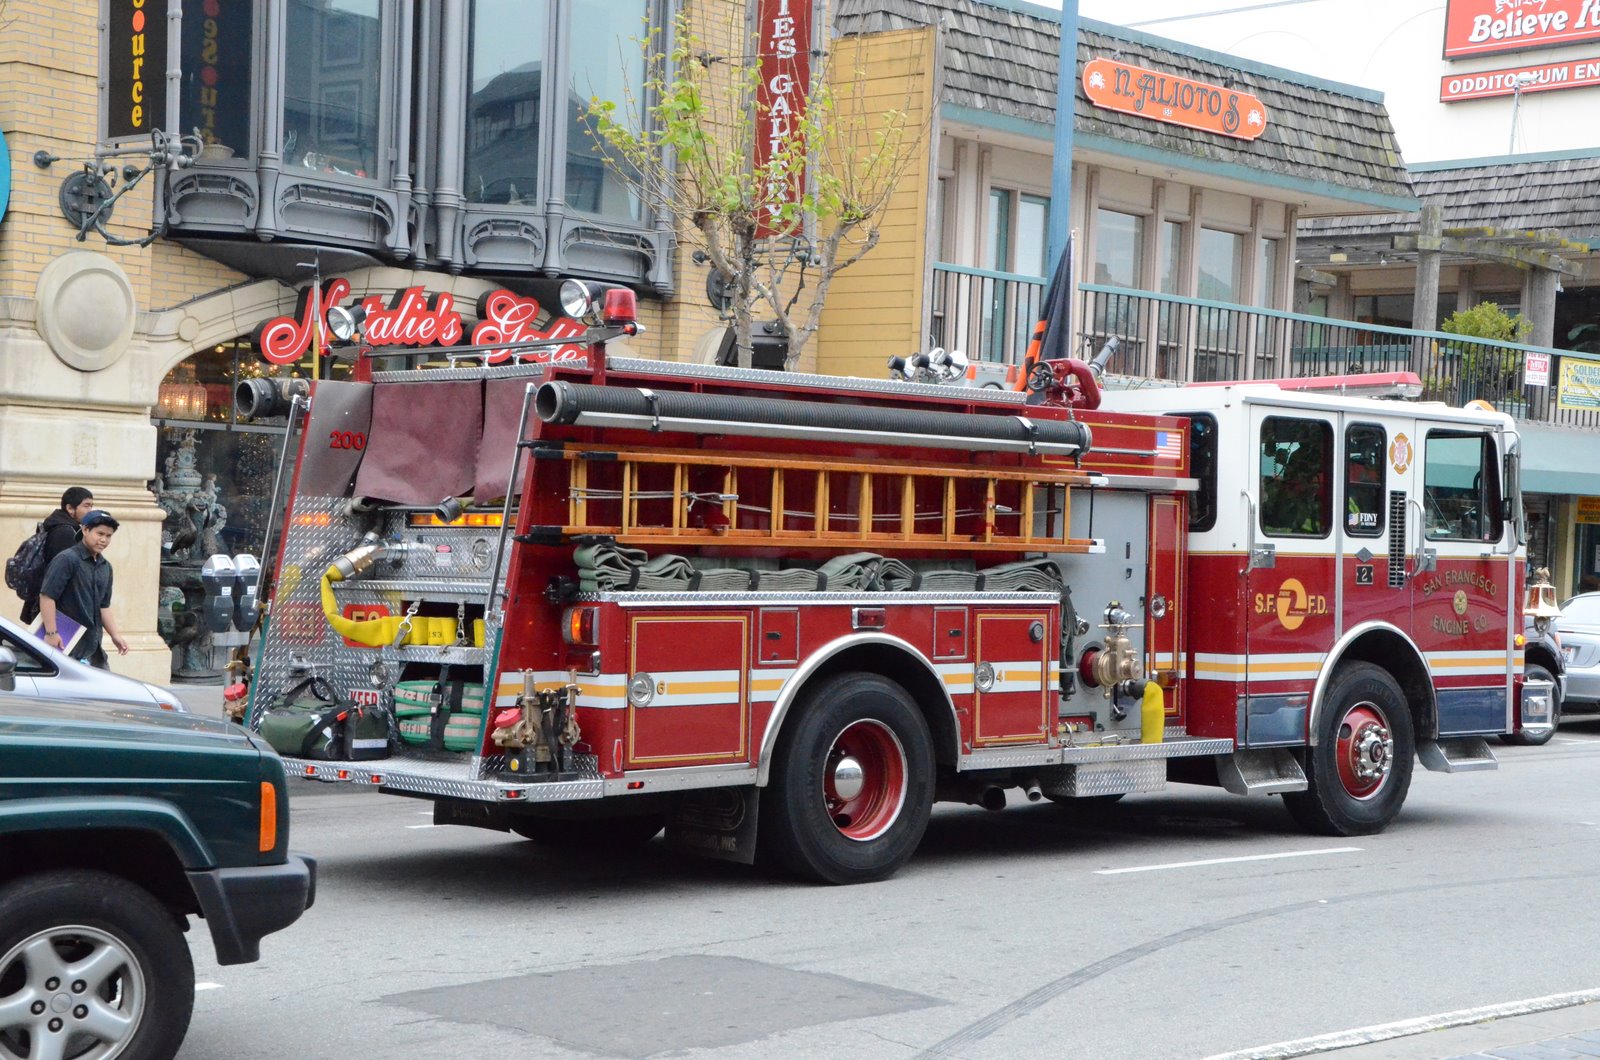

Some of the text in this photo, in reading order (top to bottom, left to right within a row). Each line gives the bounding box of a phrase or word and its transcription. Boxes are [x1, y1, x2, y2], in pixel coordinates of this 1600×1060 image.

[1468, 9, 1569, 43] Believe
[1448, 66, 1569, 94] ODDITOUM
[265, 284, 458, 358] Ntalie's
[329, 430, 367, 451] 200
[1359, 513, 1378, 522] FDNY
[1361, 567, 1368, 582] 2
[1423, 569, 1497, 597] SAN FRANCISCO
[1168, 599, 1174, 611] 2
[1254, 592, 1276, 614] S.F.
[1307, 594, 1329, 615] F.D.
[1432, 614, 1469, 635] ENGINE
[996, 669, 1003, 682] 4
[656, 680, 665, 695] 6
